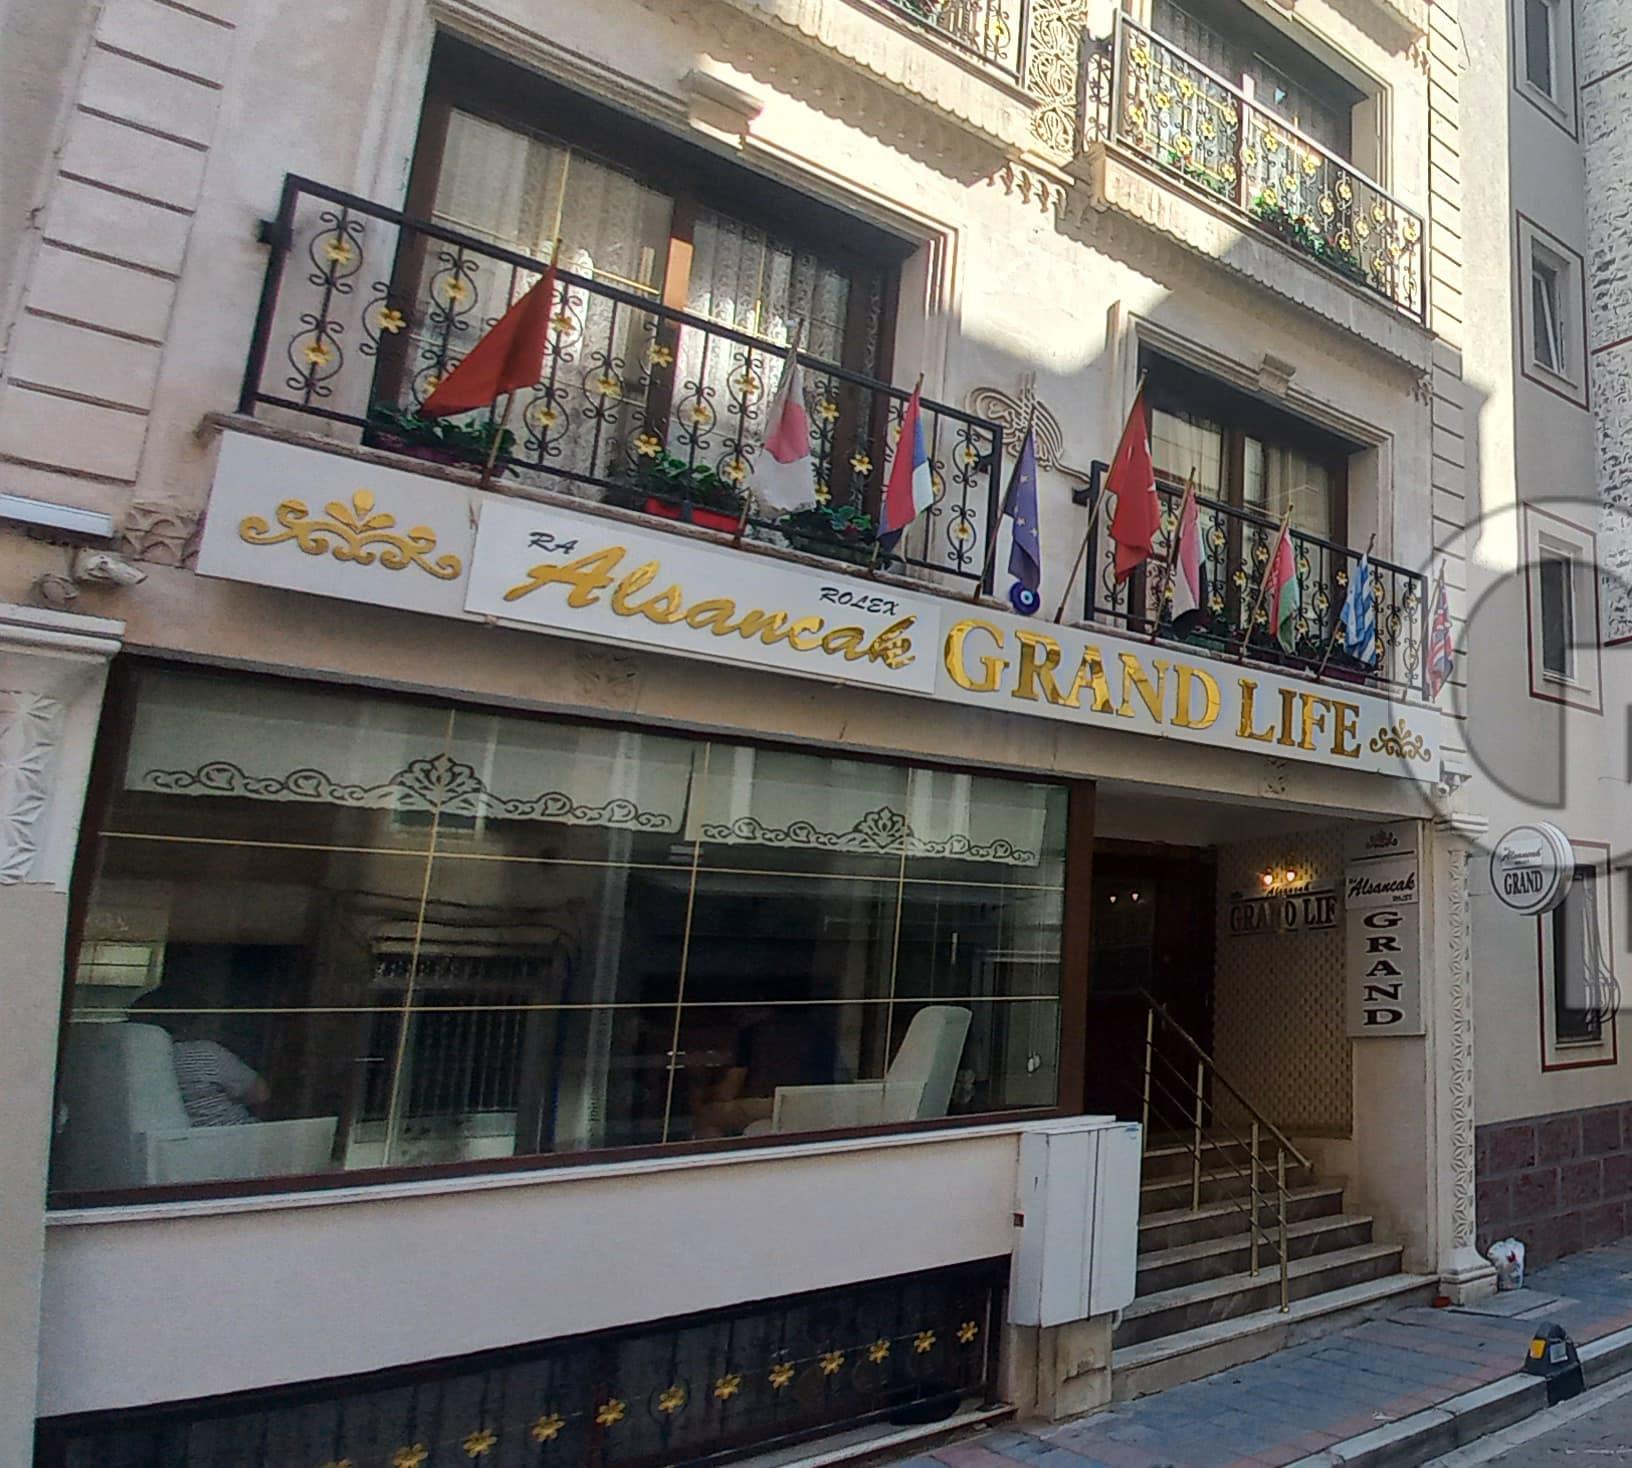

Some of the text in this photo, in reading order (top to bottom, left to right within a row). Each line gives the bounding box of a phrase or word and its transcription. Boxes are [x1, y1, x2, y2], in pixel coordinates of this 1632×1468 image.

[528, 532, 579, 555] RA
[819, 586, 901, 616] ROLEX
[503, 545, 1362, 758] Alsancak GRAND LIFE
[1347, 872, 1415, 898] Alsancak
[1504, 870, 1543, 895] GRAND
[1231, 899, 1297, 932] GRAD
[1363, 911, 1403, 1026] GRAND
